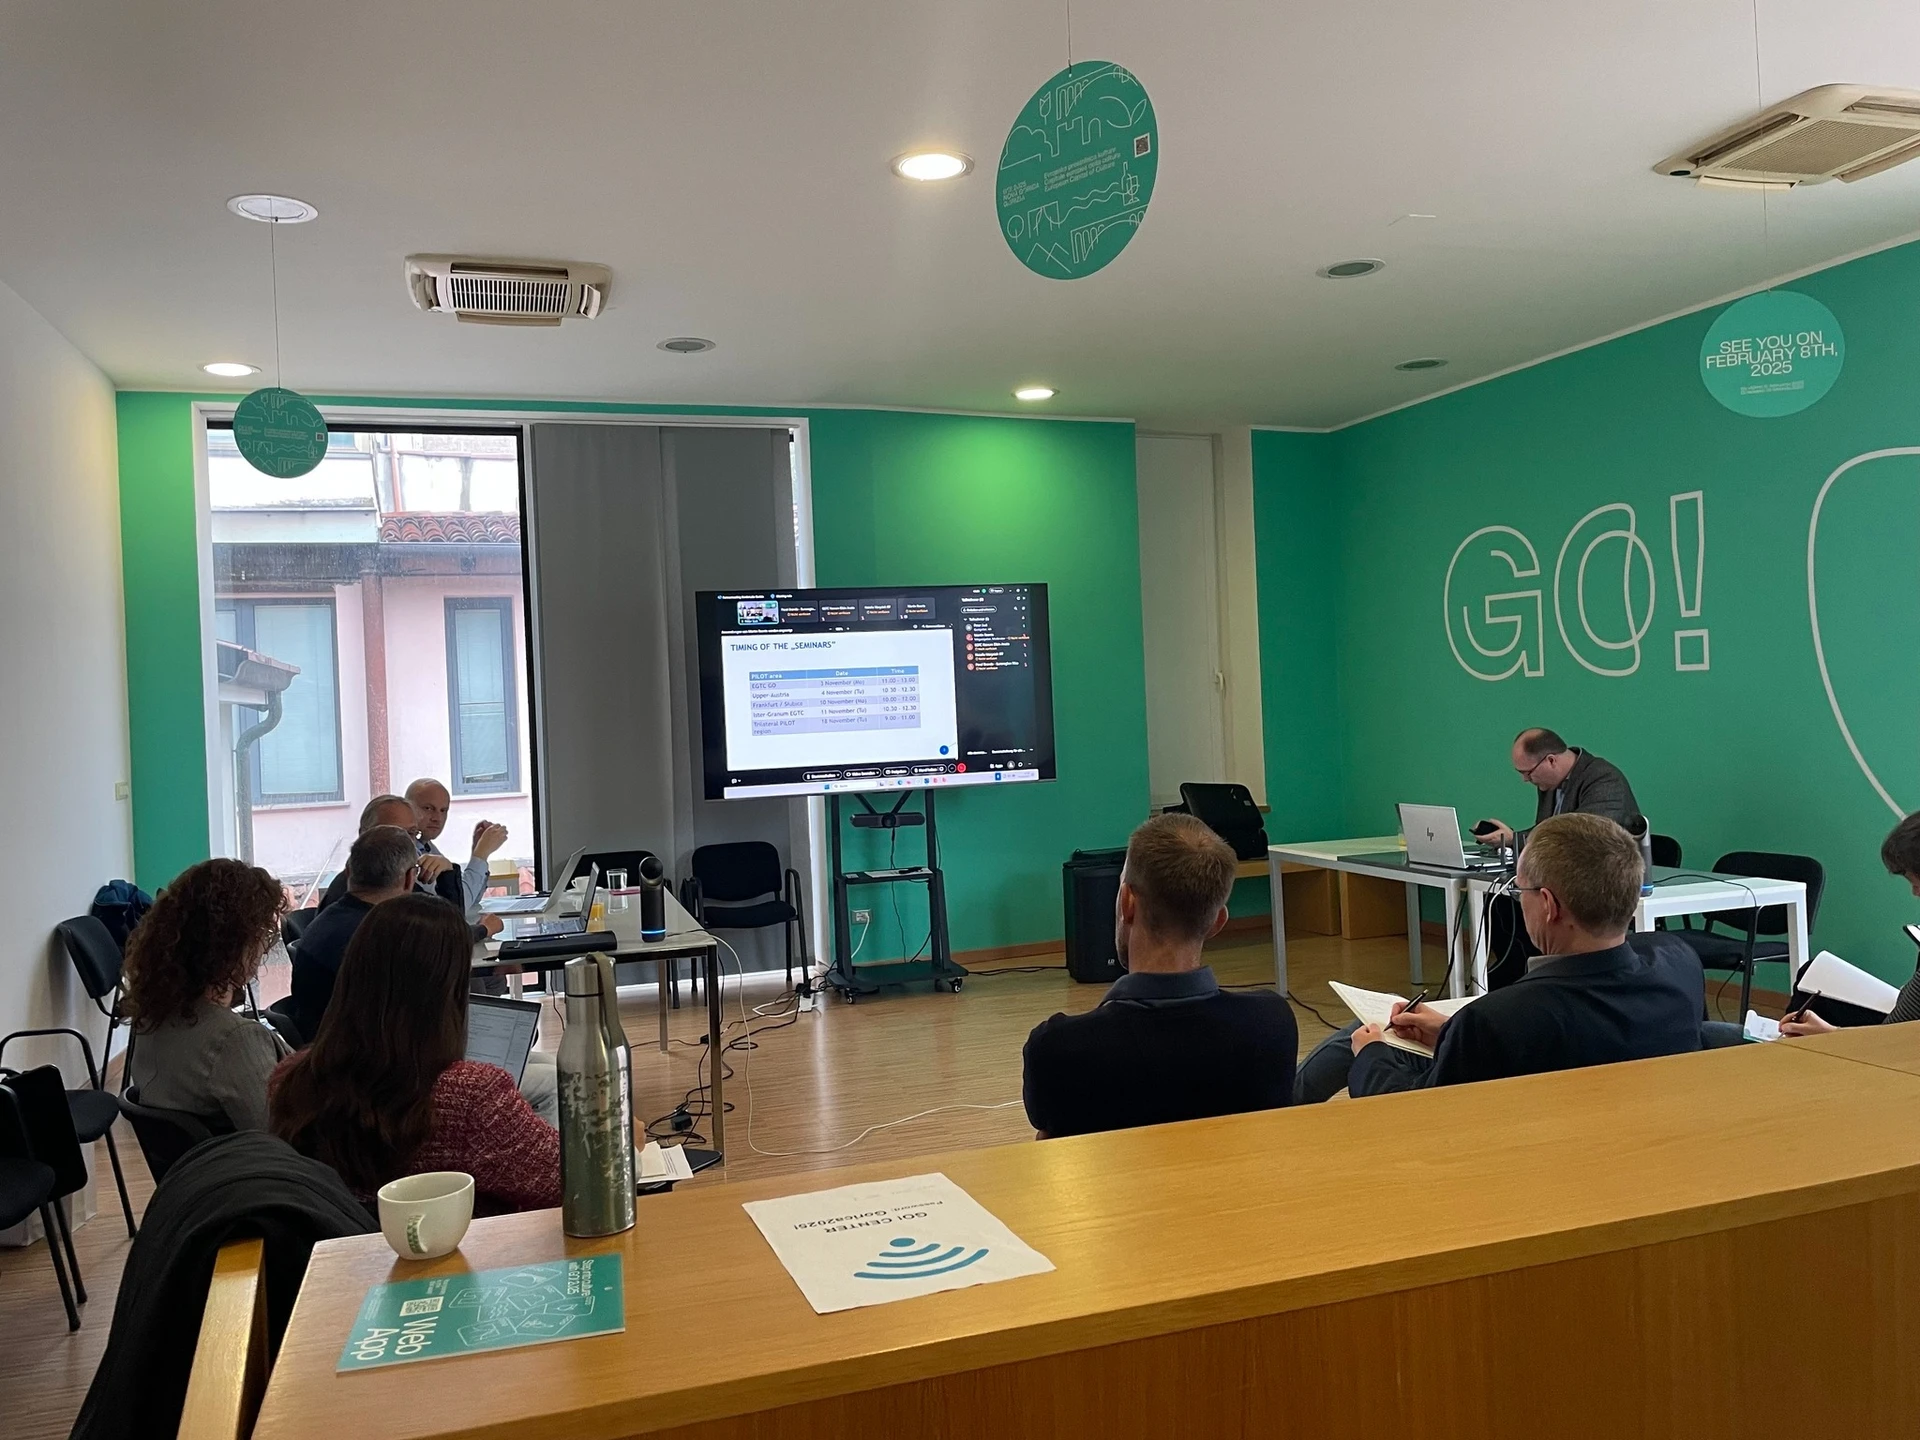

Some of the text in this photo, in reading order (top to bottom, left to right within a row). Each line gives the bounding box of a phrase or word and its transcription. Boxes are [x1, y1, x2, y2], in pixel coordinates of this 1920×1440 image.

[1720, 330, 1823, 354] SEE YOU ON
[1706, 342, 1838, 369] FEBRUARY 8TH,
[1750, 361, 1793, 377] 2025
[1443, 490, 1710, 682] GO!
[730, 644, 758, 652] TIMING
[793, 1210, 887, 1230] Gorica2025!
[824, 1212, 928, 1233] GO! CENTER
[350, 1328, 400, 1360] App
[394, 1316, 440, 1355] Web
